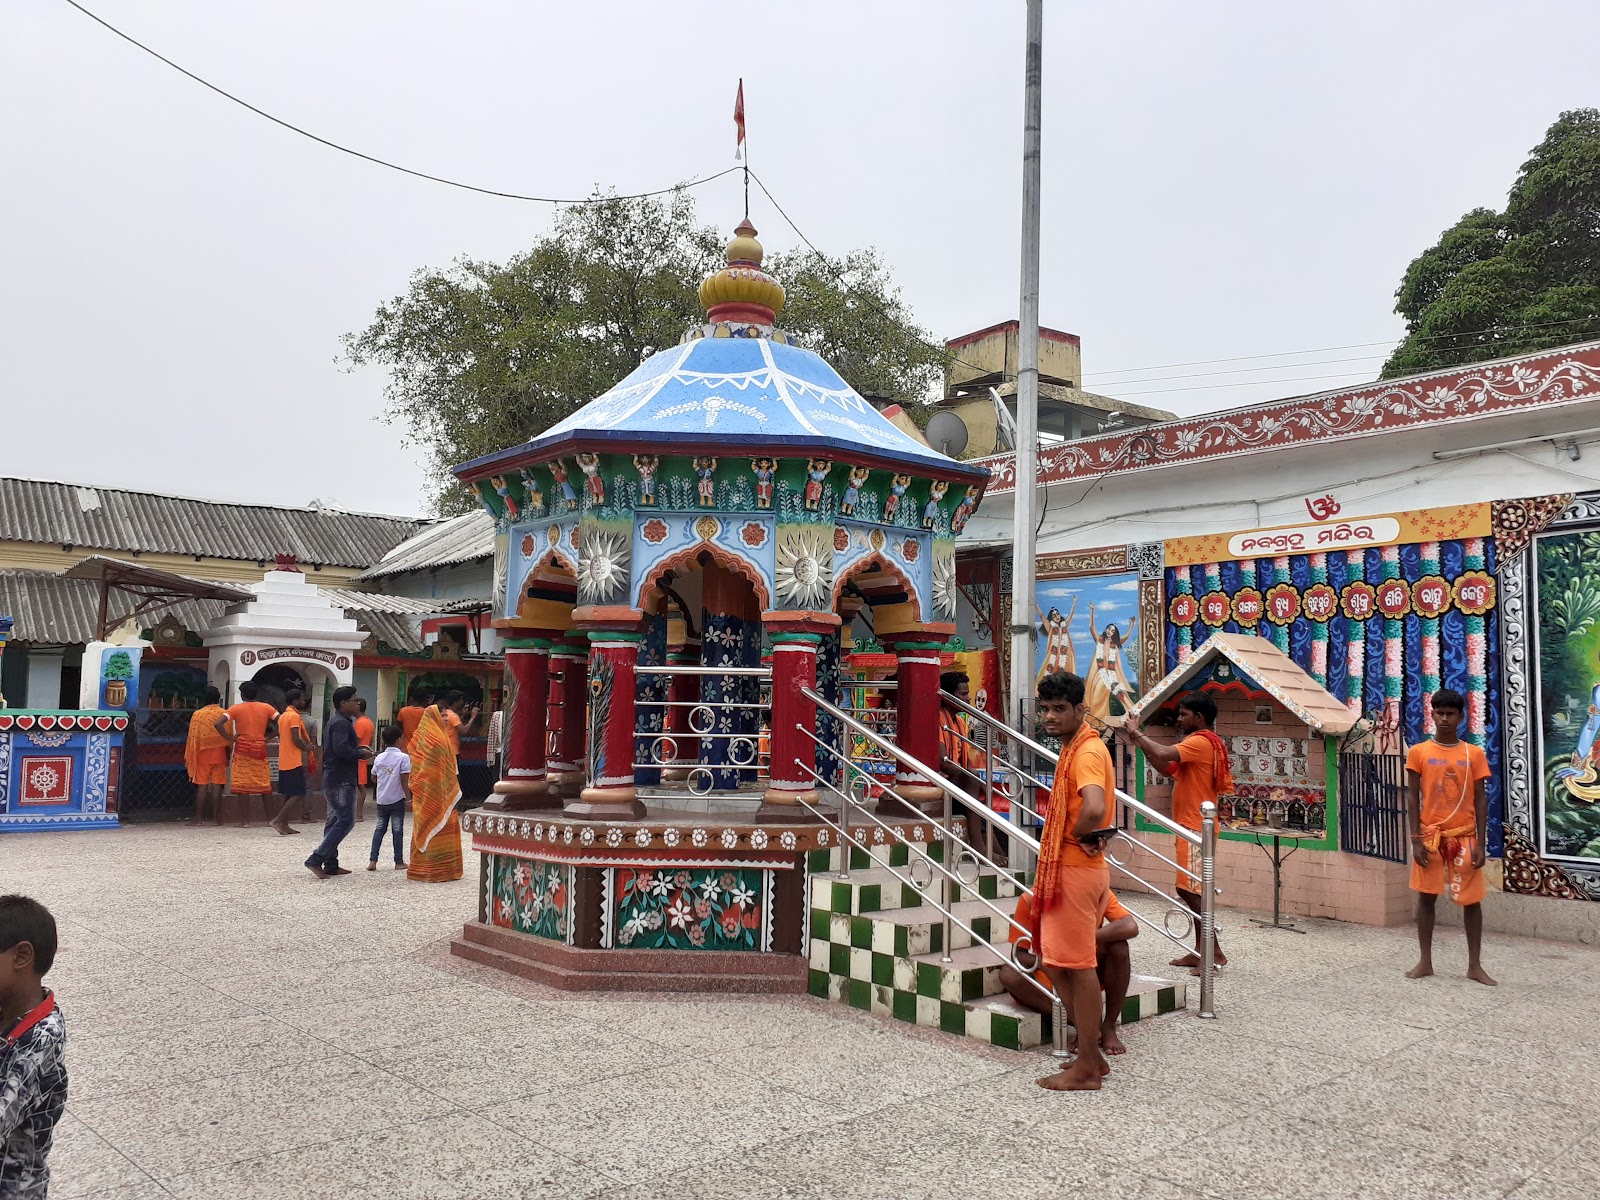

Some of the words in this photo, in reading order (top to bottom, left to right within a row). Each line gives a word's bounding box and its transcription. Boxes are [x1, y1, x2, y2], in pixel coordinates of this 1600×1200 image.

[1241, 533, 1305, 551] ନବଗ୍ରହ
[1317, 524, 1375, 544] ମନ୍ଦିର
[1384, 587, 1403, 606] ଶନି
[1421, 587, 1443, 610] ରାହୁ
[1461, 585, 1486, 605] କେତୁ
[1177, 600, 1190, 616] ରବି
[1275, 597, 1289, 617] ବୁଧ
